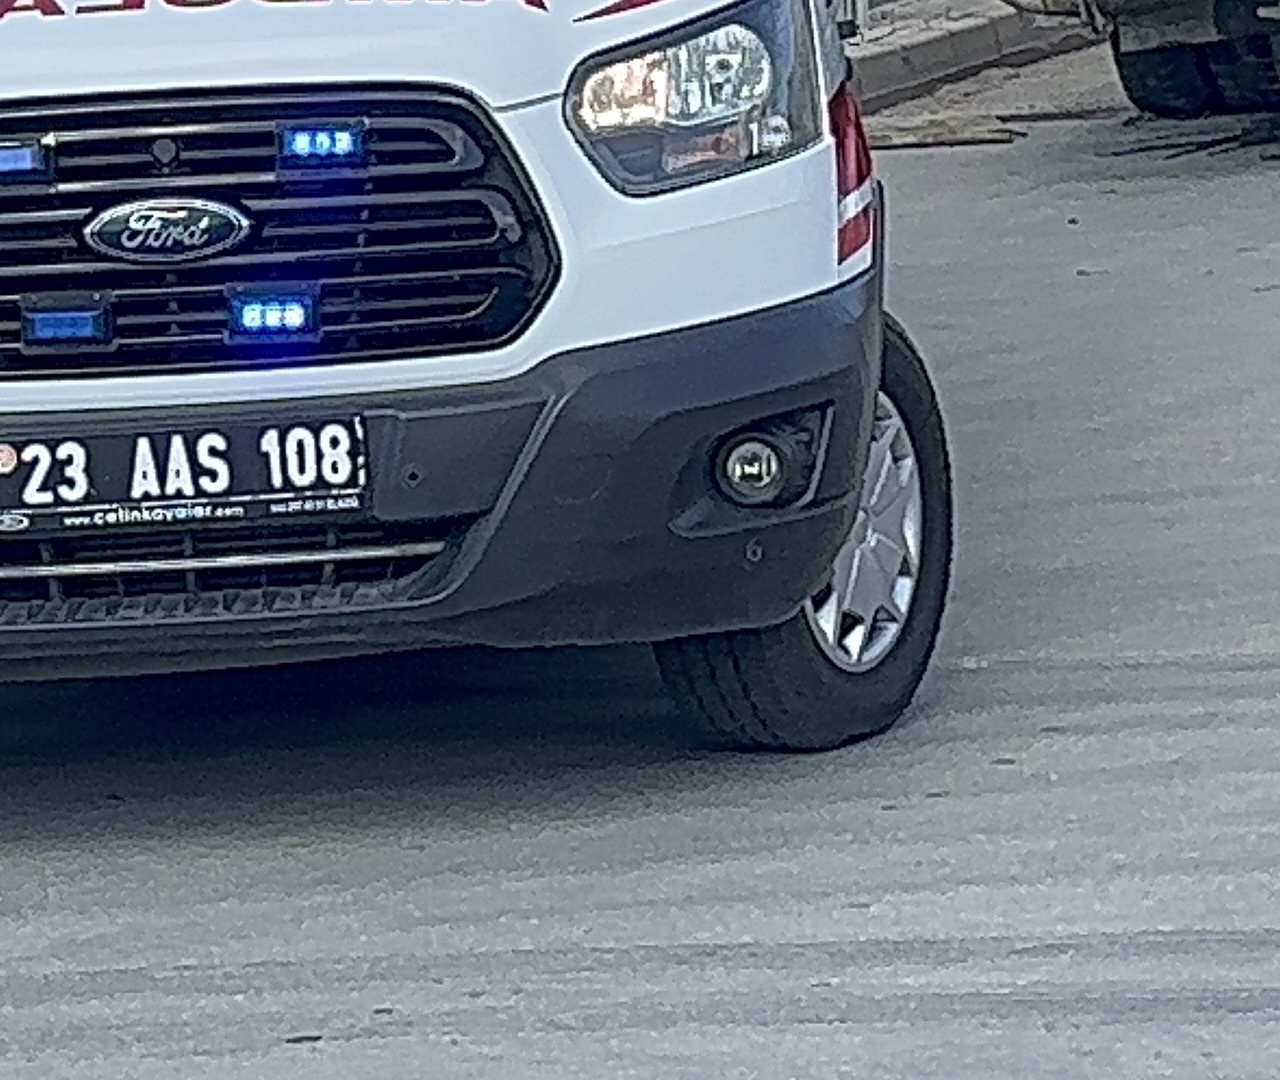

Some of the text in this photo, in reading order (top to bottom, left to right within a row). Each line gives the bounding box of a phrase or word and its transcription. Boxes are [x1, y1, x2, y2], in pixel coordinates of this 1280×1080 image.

[120, 209, 210, 249] Ford
[20, 423, 353, 505] 23 AAS 108
